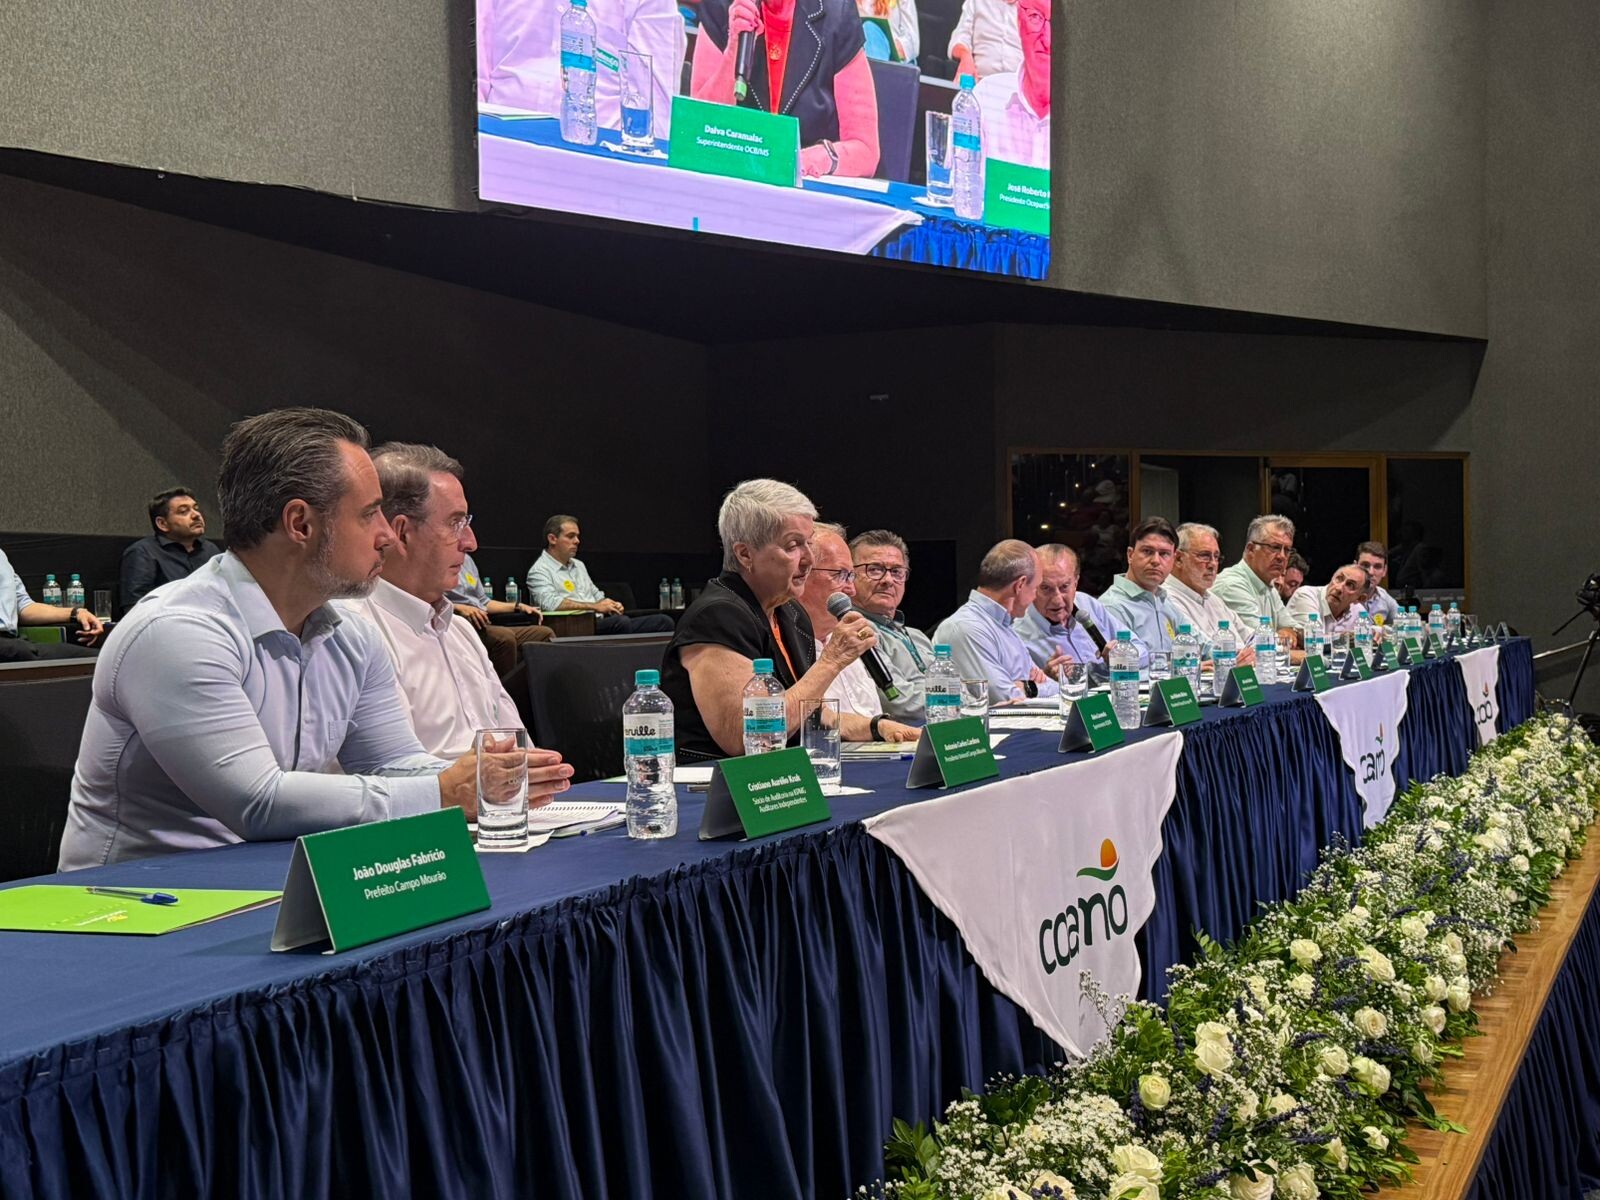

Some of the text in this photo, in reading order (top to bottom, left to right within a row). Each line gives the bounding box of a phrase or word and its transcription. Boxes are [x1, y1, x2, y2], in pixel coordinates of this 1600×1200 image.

[704, 124, 725, 136] Dalva
[748, 782, 771, 792] Cristiano
[353, 848, 446, 881] João Douglas Fabrício
[363, 871, 447, 900] Prefeito Campo Mourão
